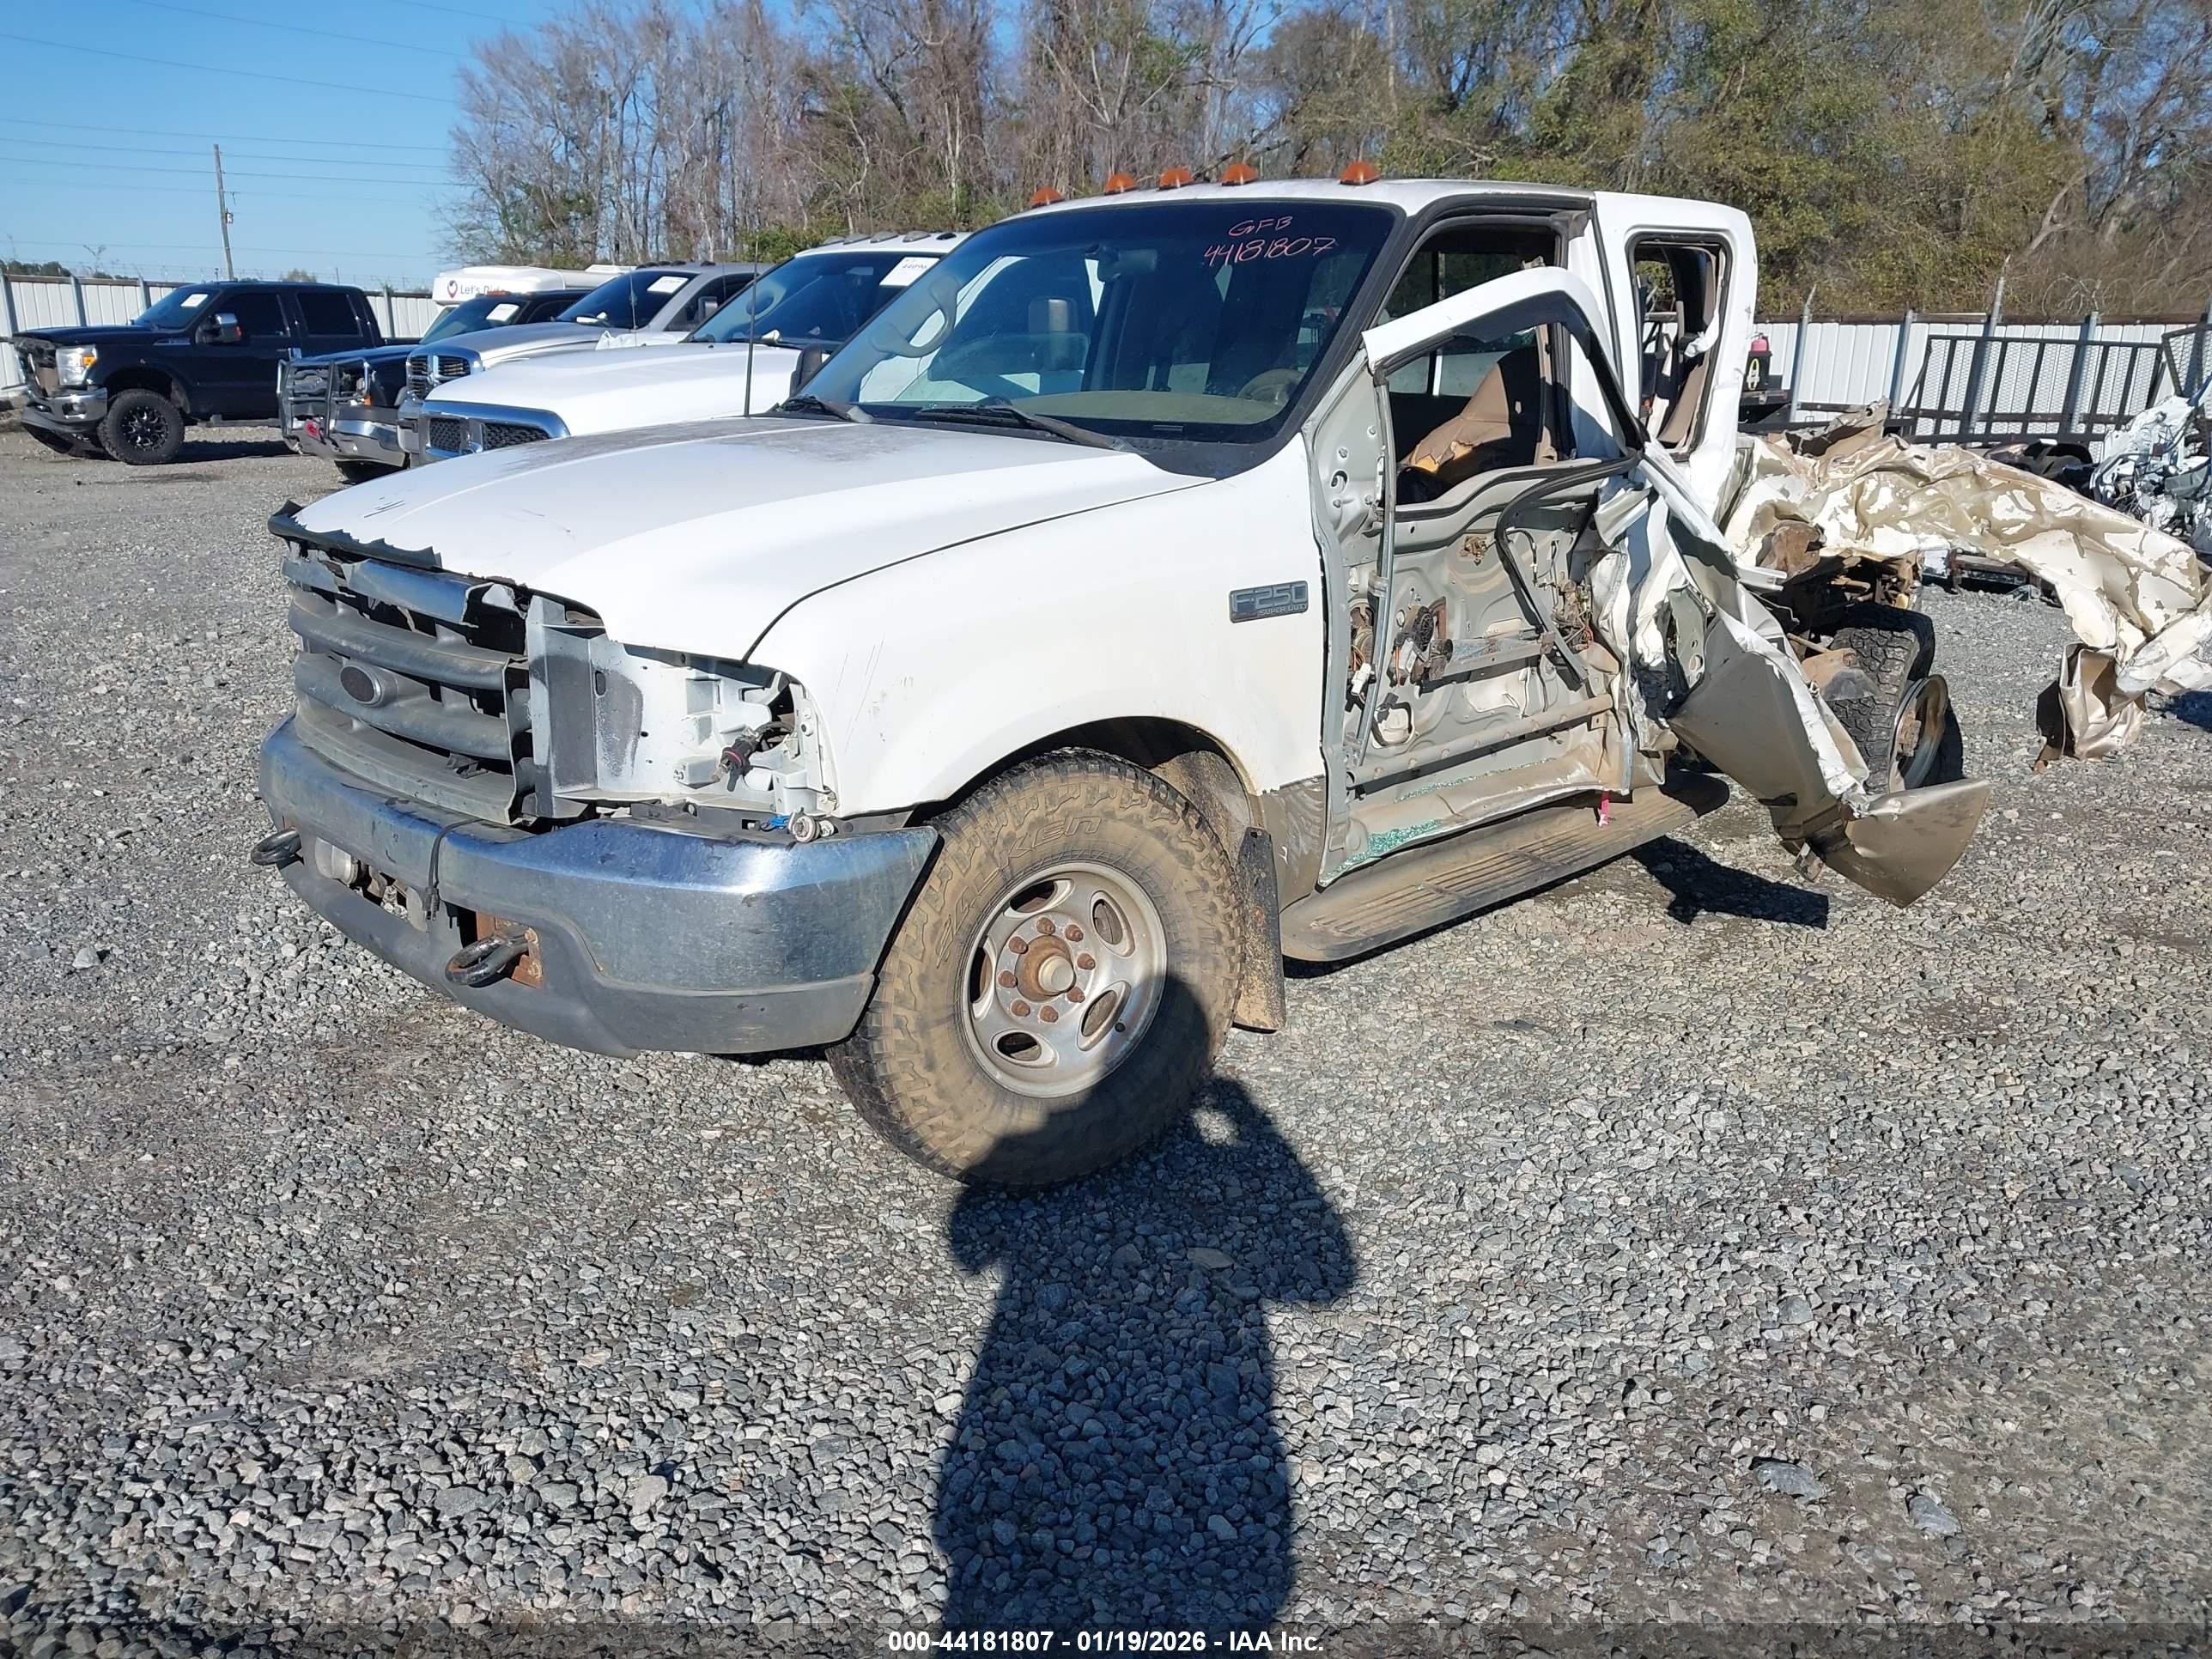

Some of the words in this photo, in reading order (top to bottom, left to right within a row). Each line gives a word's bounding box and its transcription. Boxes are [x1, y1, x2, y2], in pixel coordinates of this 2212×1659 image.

[1228, 216, 1293, 237] GFB
[1204, 237, 1336, 267] 44181807
[460, 284, 481, 295] Let's
